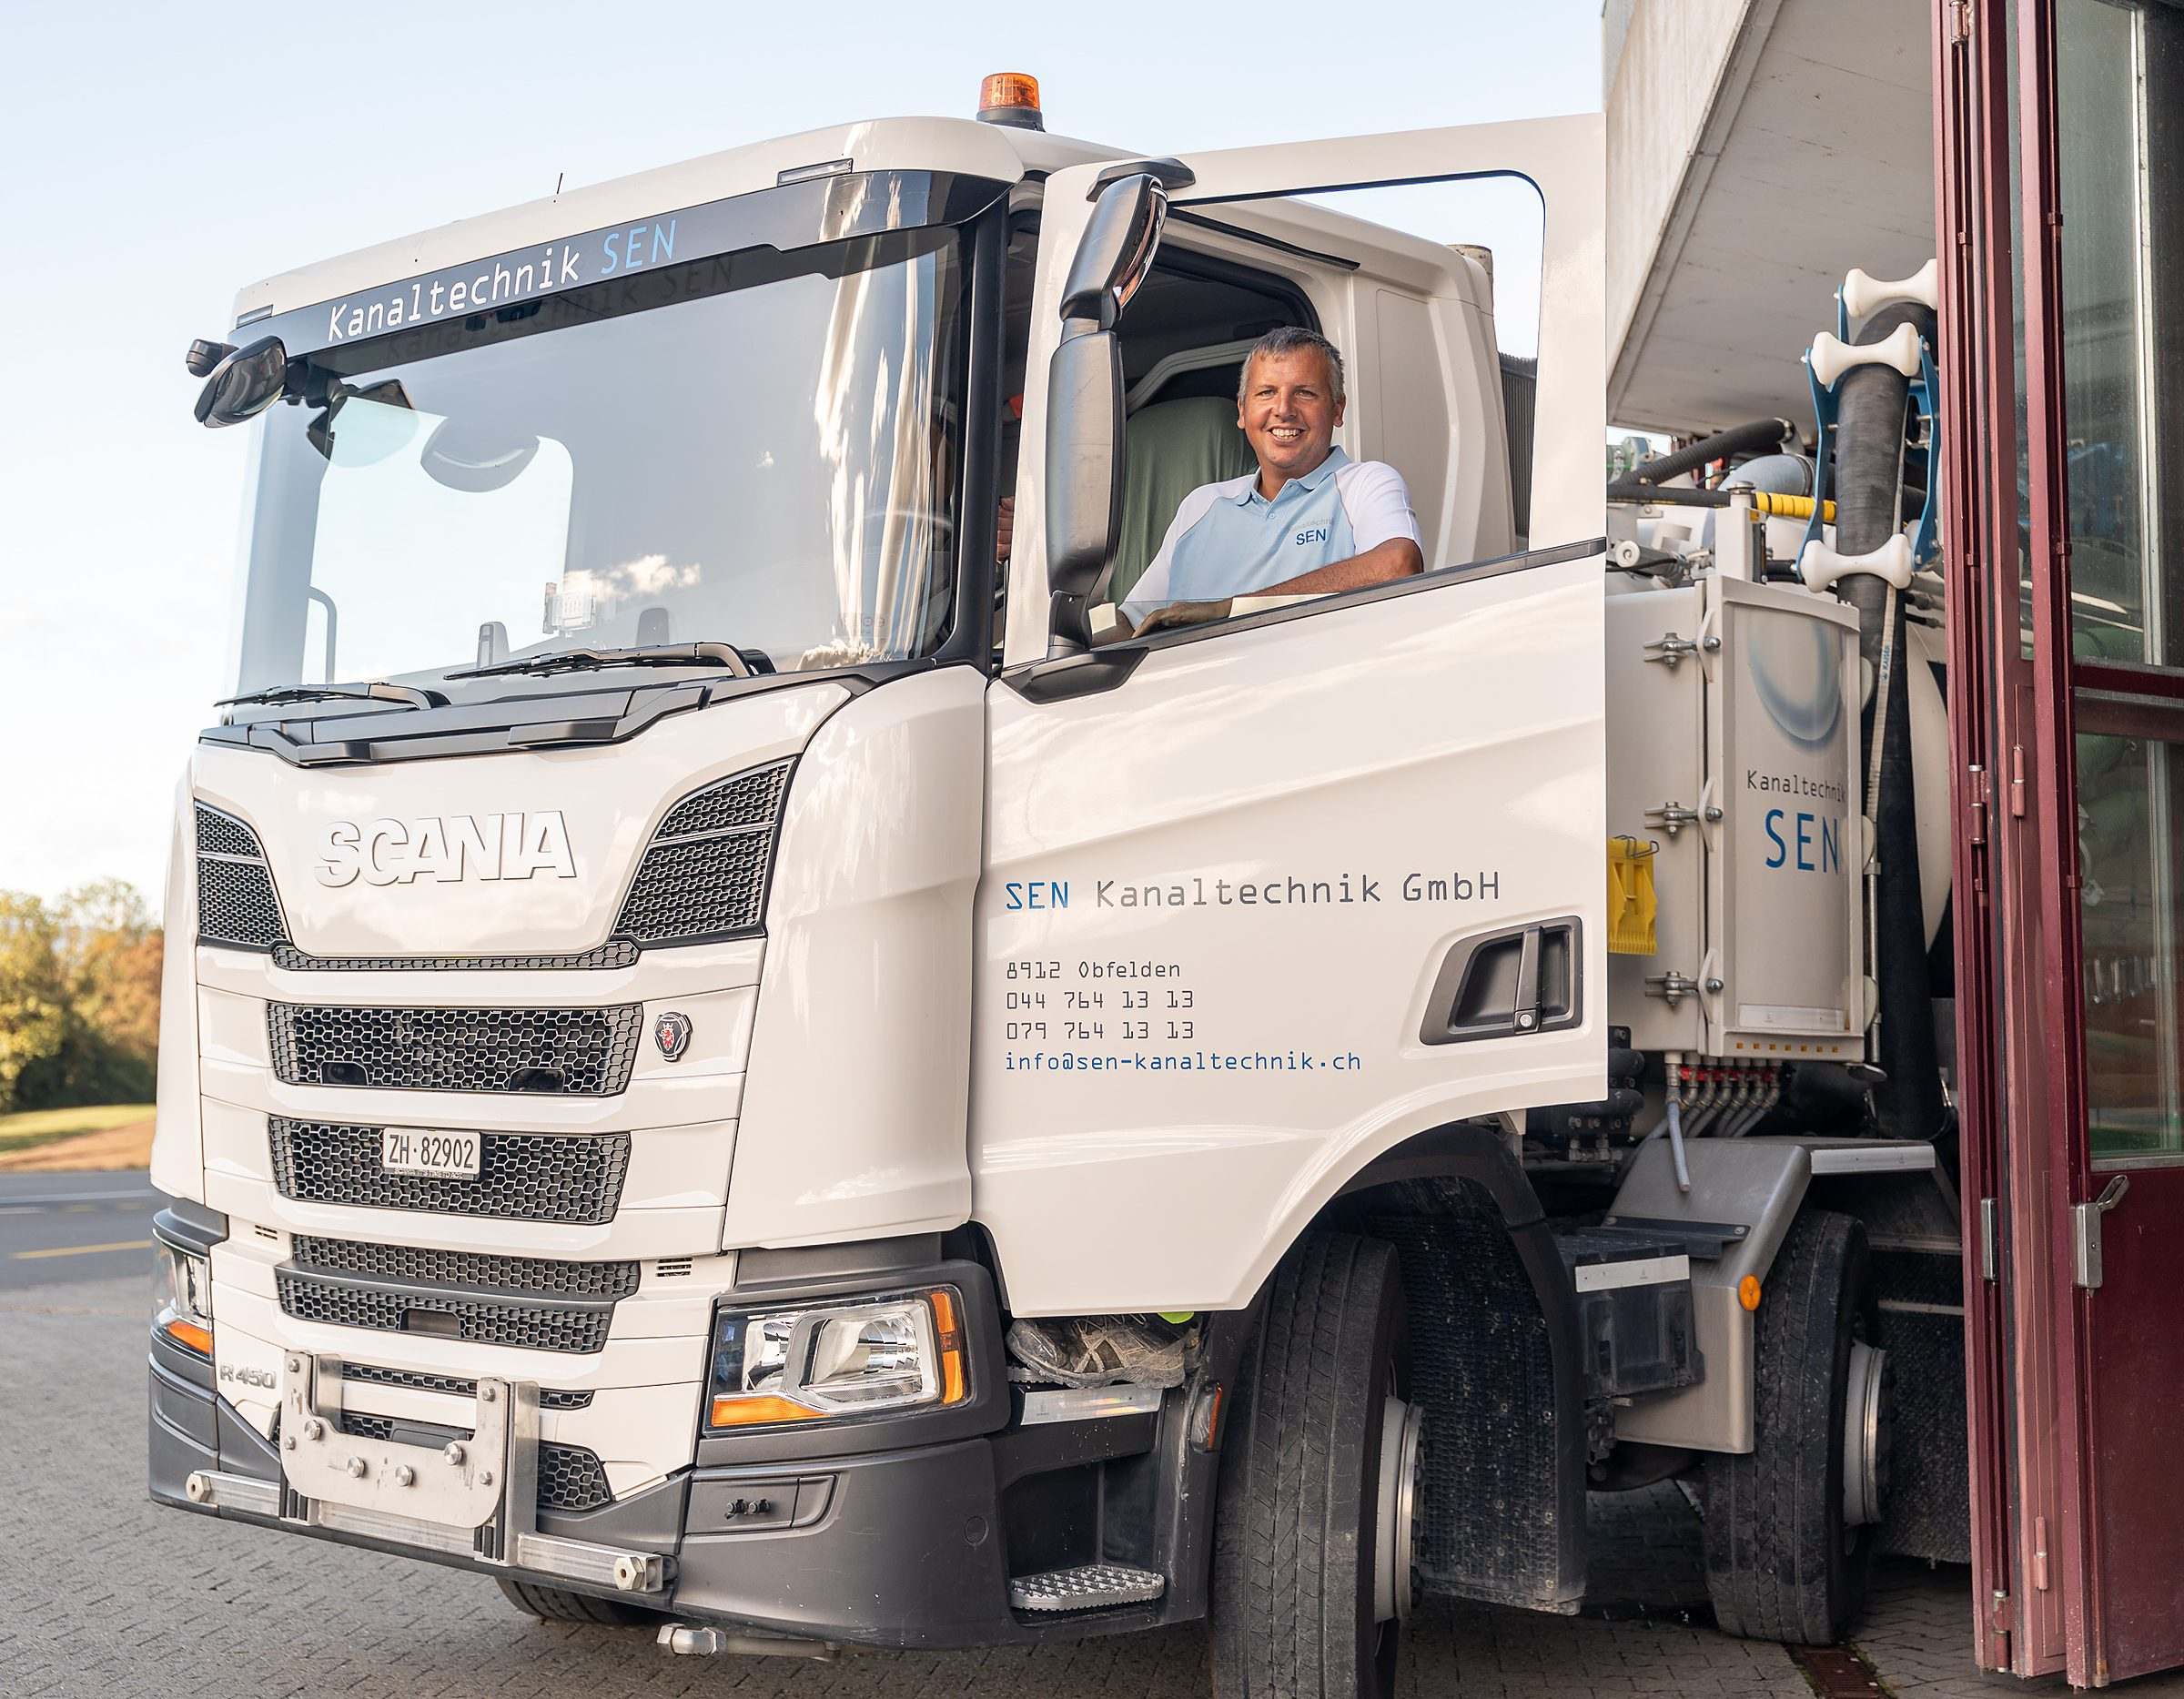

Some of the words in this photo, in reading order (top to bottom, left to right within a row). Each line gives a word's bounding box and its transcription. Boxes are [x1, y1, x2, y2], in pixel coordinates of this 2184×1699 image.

[328, 245, 581, 342] Kanaltechnik
[601, 220, 676, 274] SEN
[1296, 528, 1327, 546] SEN
[1746, 770, 1846, 804] Kanaltechnik
[314, 810, 577, 888] SCANIA
[1764, 808, 1839, 875] SEN
[1006, 882, 1069, 910] SEN
[1097, 873, 1381, 908] Kanaltechnik
[1402, 871, 1500, 902] GmbH
[1006, 961, 1061, 980] 8912
[1078, 960, 1180, 979] Obfelden
[1006, 991, 1046, 1010] 044
[1064, 990, 1104, 1009] 764
[1121, 990, 1148, 1009] 13
[1167, 990, 1194, 1008] 13
[1006, 1021, 1046, 1040] 079
[1064, 1021, 1104, 1040] 764
[1122, 1021, 1148, 1039] 13
[1167, 1020, 1194, 1039] 13
[1005, 1051, 1361, 1071] info@sen-kanaltechnik.ch
